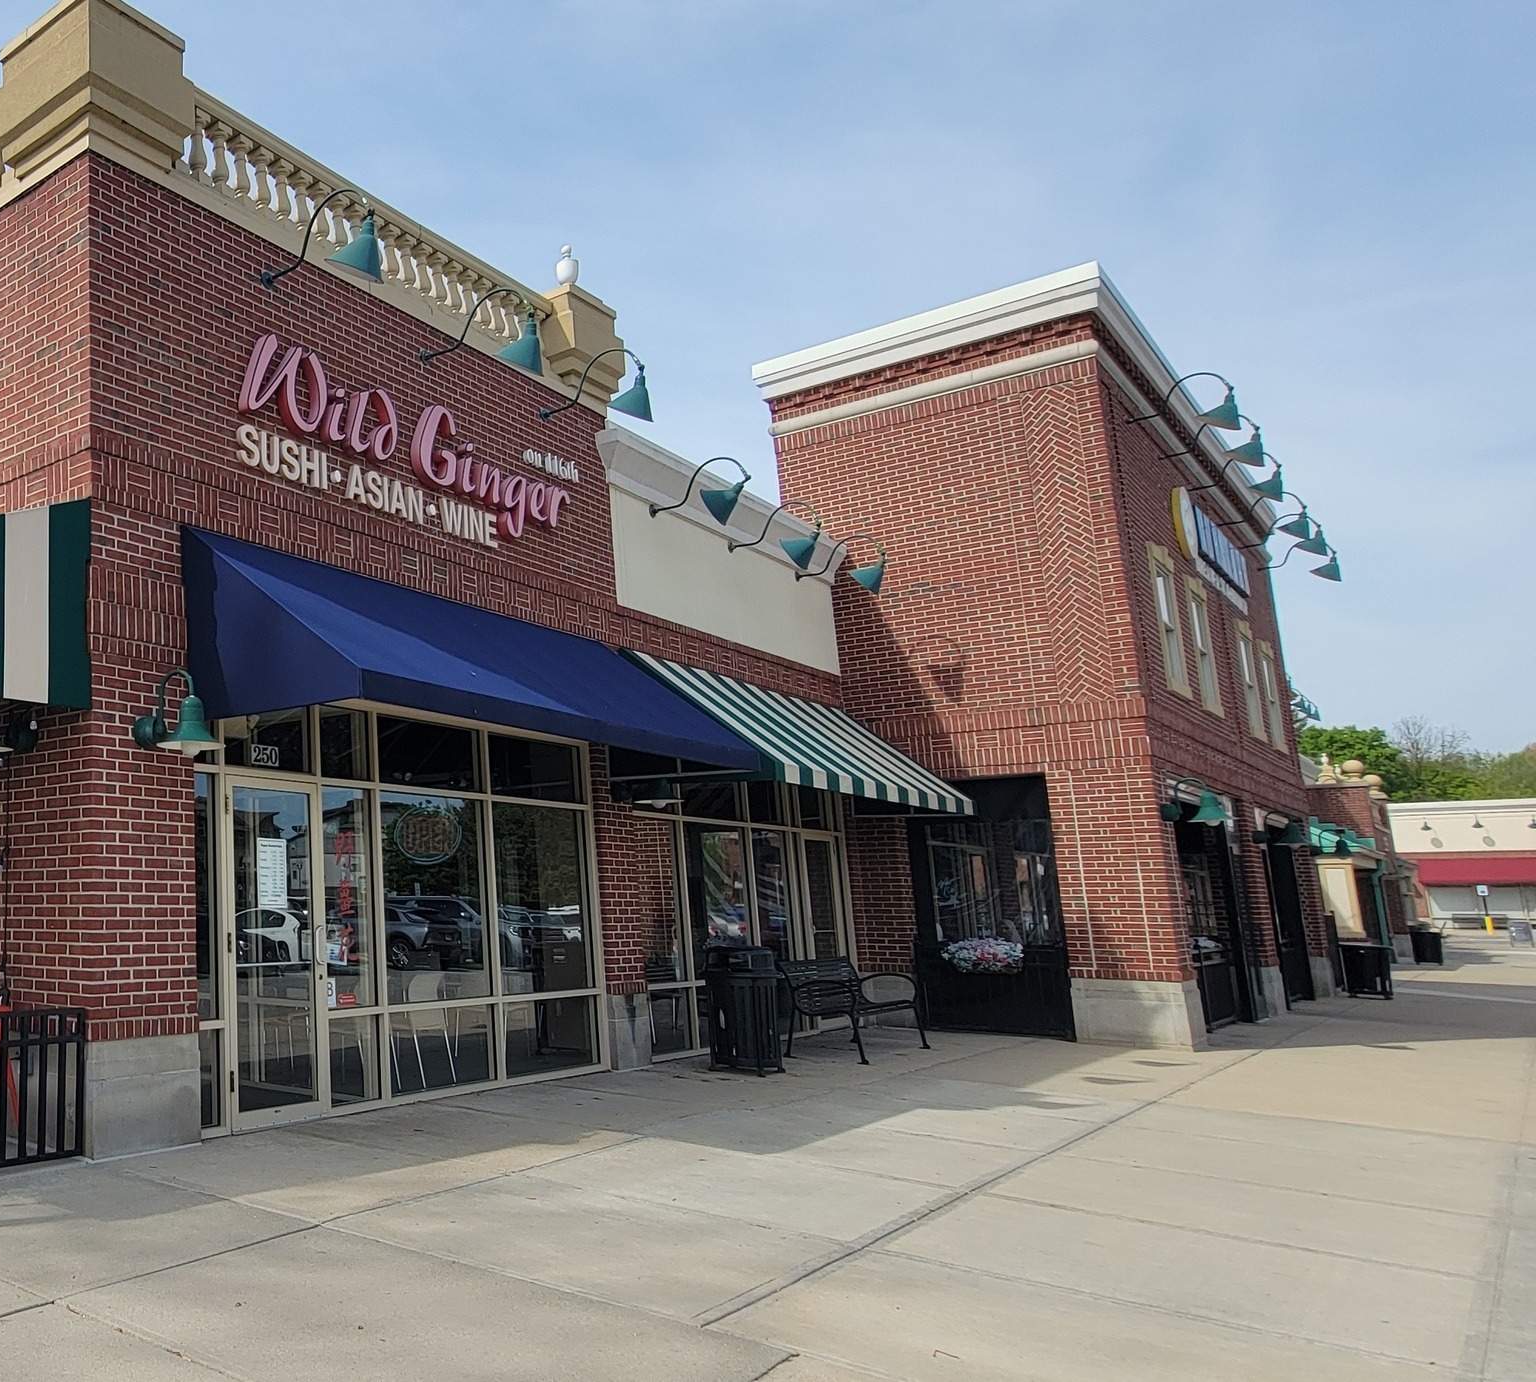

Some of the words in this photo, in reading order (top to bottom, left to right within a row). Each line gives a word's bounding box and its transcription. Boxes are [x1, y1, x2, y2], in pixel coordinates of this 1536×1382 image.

[238, 333, 398, 461] Wild
[411, 405, 570, 542] Ginger
[523, 449, 543, 468] on
[545, 453, 579, 483] 116th
[236, 424, 330, 491] SUSHI
[345, 464, 424, 525] ASIAN
[438, 497, 498, 548] WINE
[253, 745, 277, 765] 250
